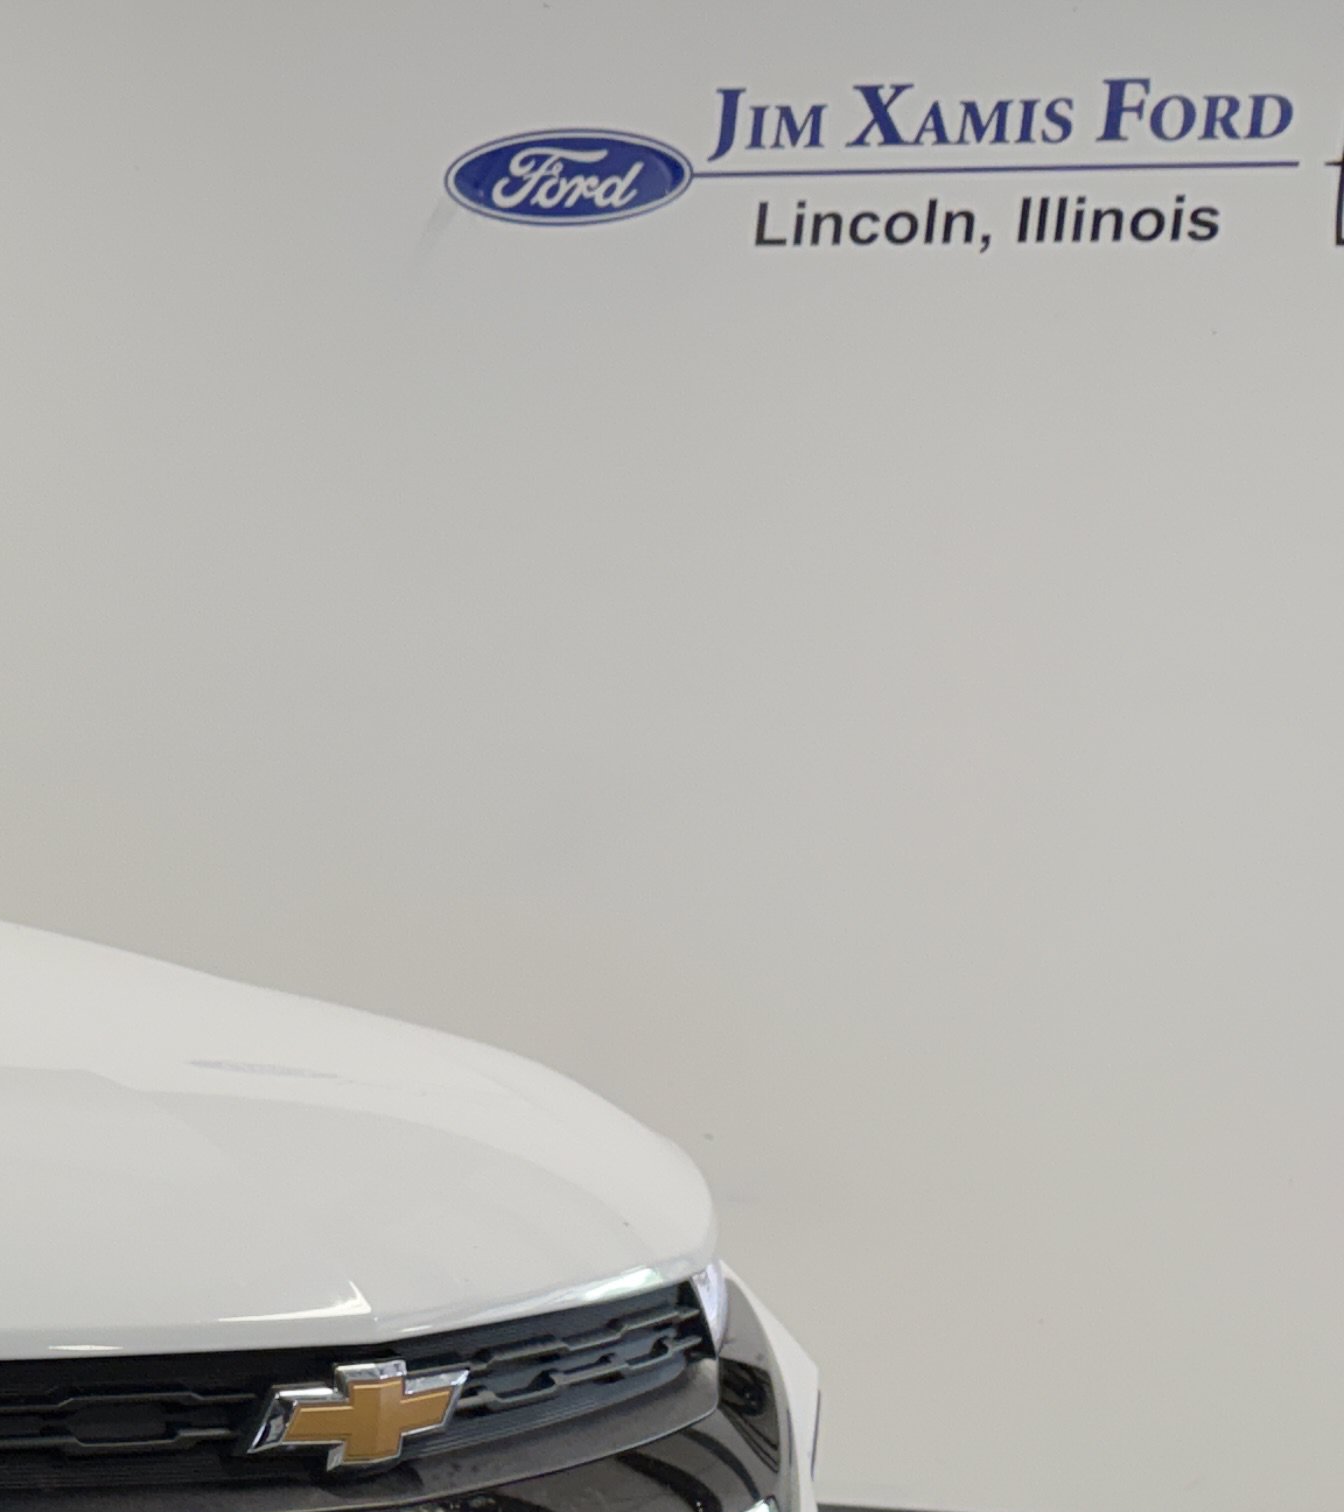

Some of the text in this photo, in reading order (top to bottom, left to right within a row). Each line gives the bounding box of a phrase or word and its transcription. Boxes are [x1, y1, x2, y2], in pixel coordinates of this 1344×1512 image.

[706, 77, 1295, 163] JIM XAMIS FORD
[491, 146, 644, 209] Ford
[754, 194, 1221, 254] Lincoln, Illinois
